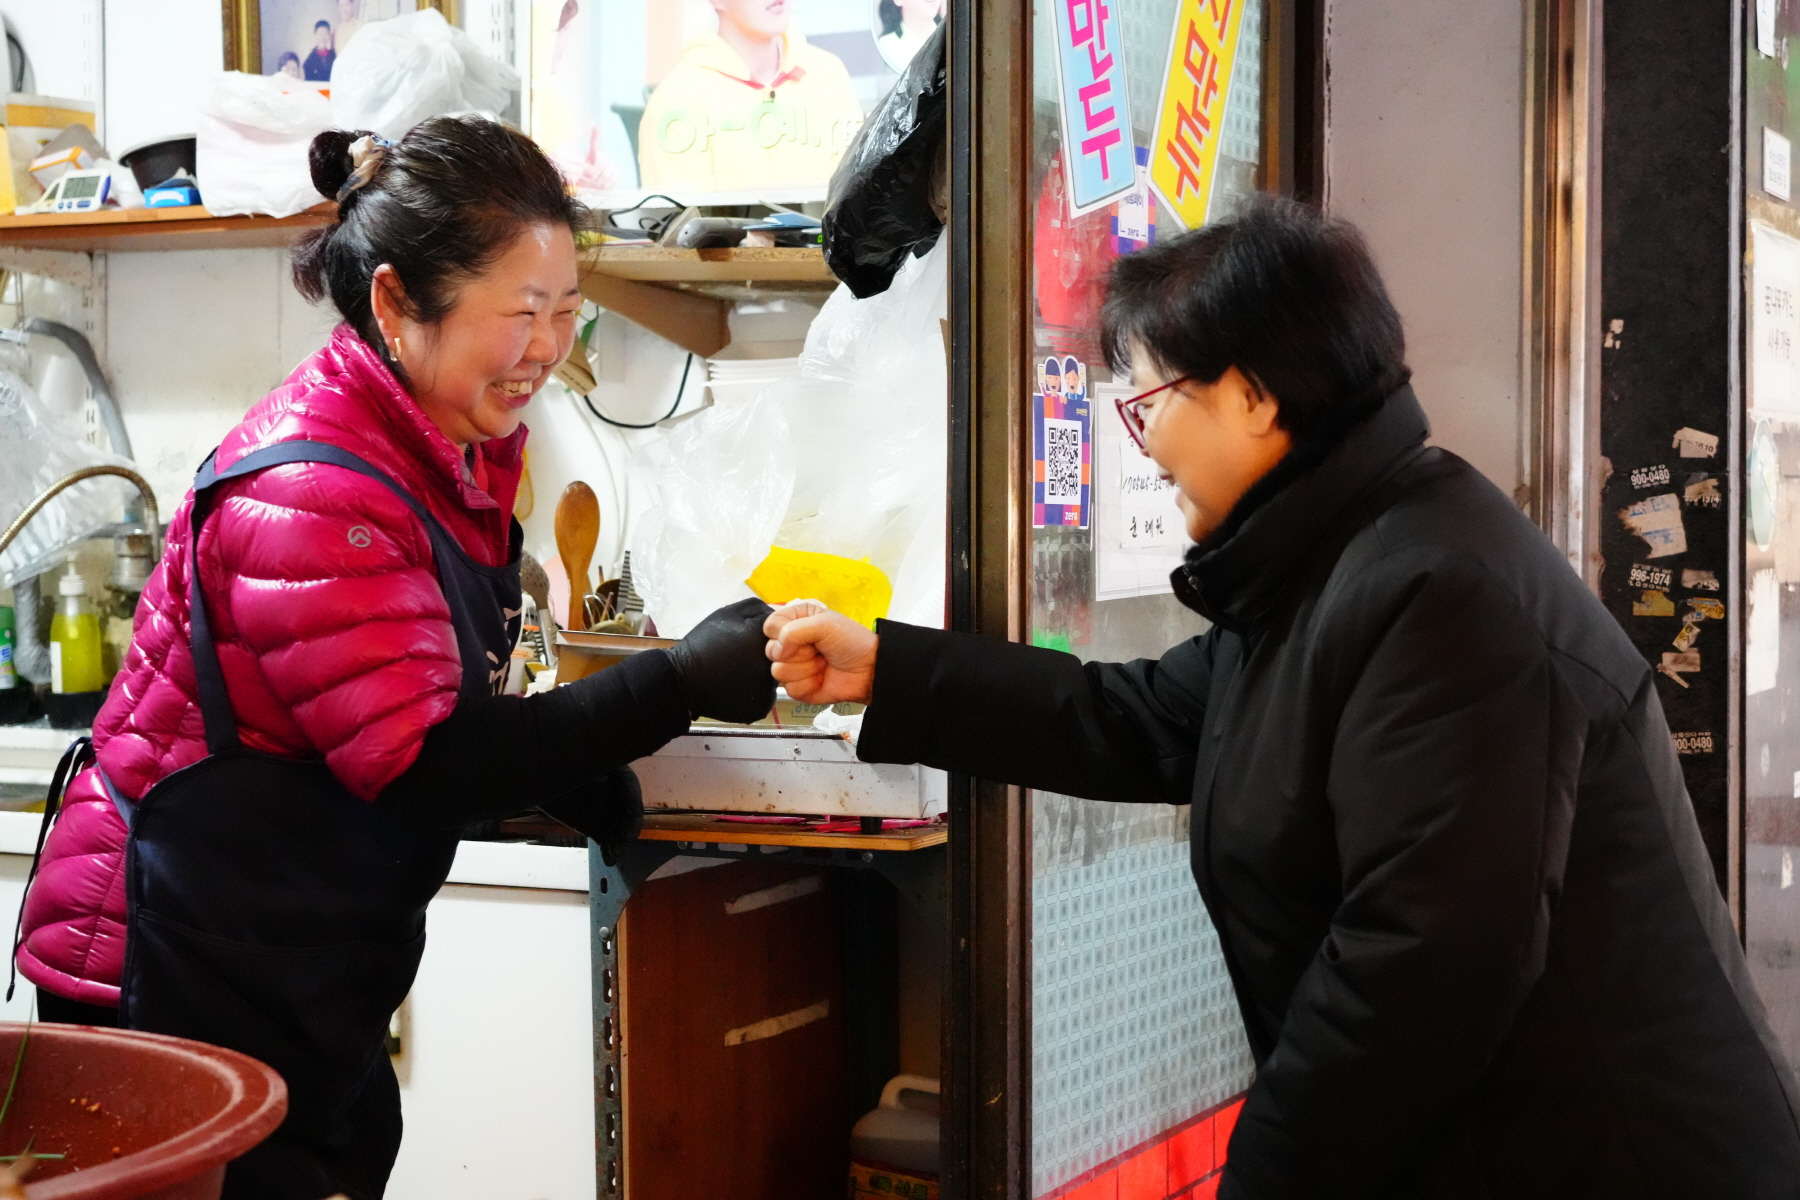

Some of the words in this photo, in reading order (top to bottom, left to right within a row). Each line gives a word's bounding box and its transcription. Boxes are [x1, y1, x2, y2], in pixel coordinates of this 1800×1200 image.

[1066, 0, 1121, 181] 만두
[1630, 468, 1670, 486] 900-0480
[1064, 511, 1078, 521] zero
[1630, 568, 1671, 587] 996-1974
